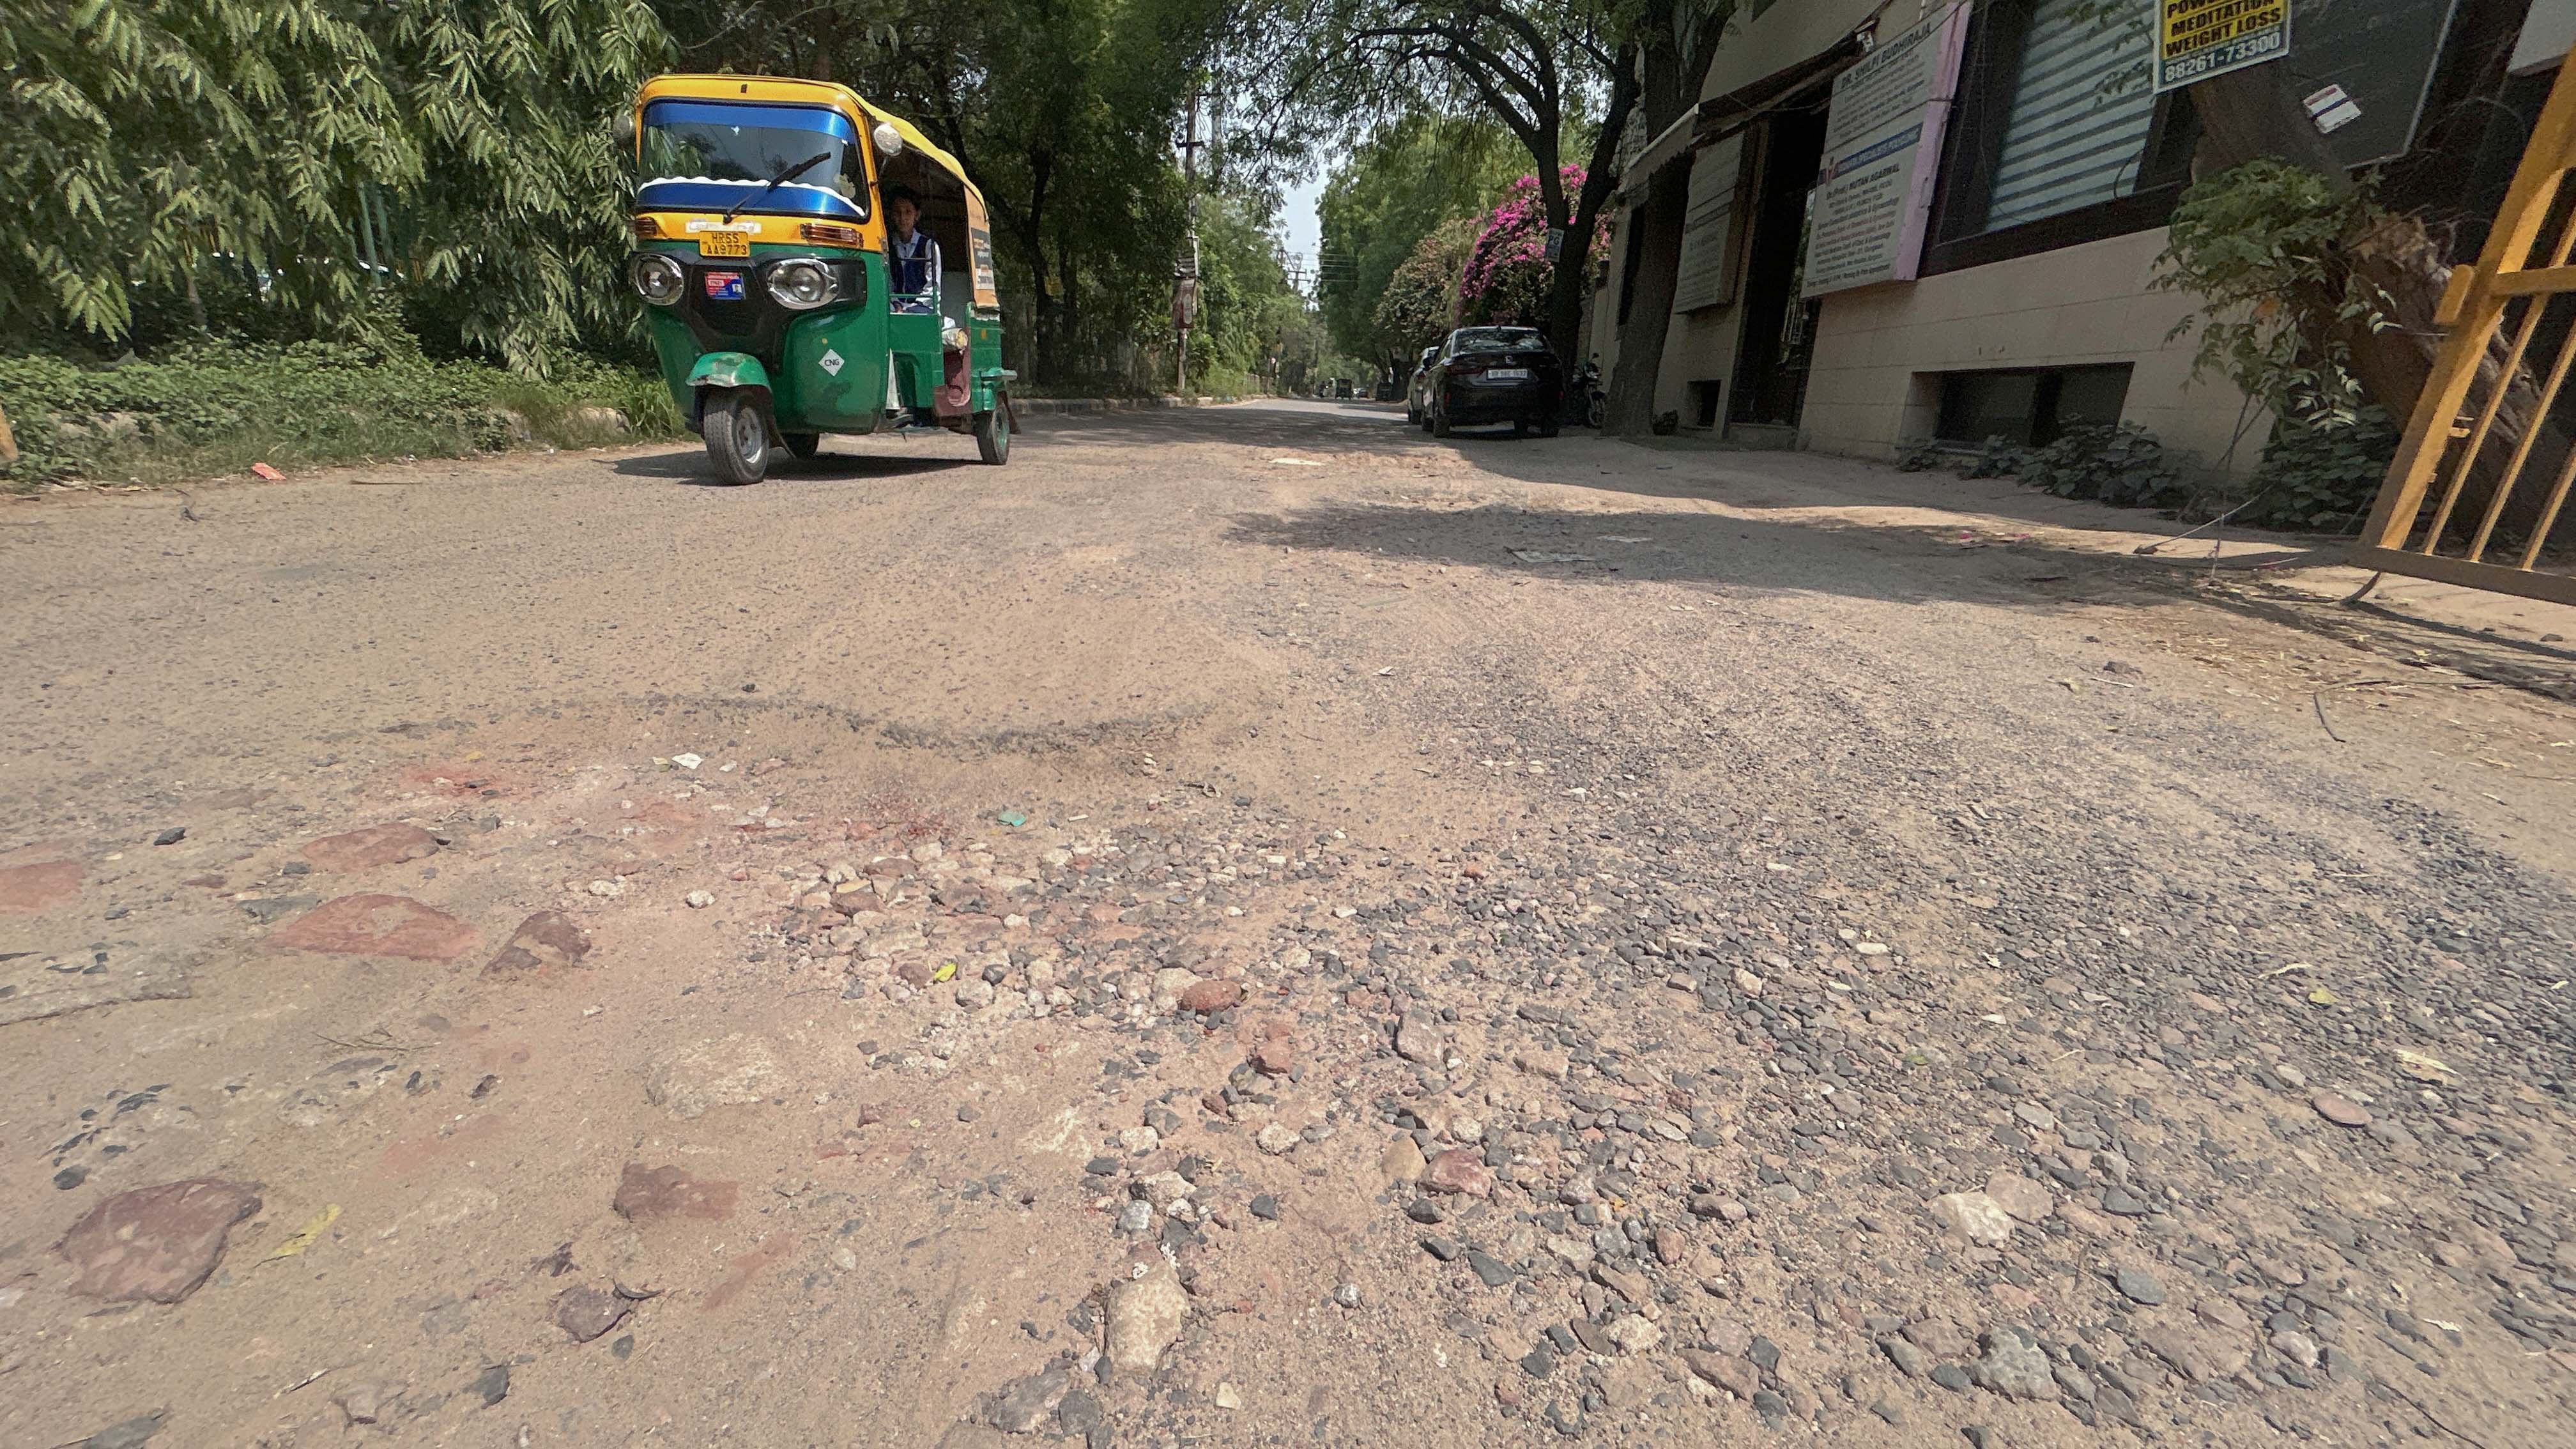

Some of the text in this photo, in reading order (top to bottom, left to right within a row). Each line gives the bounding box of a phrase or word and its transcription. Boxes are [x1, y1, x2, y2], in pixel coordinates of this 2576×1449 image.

[2166, 7, 2281, 56] WEIGHT LOSS
[2165, 32, 2281, 82] 88261-73300
[707, 244, 747, 255] AA9773
[712, 233, 739, 244] HR55
